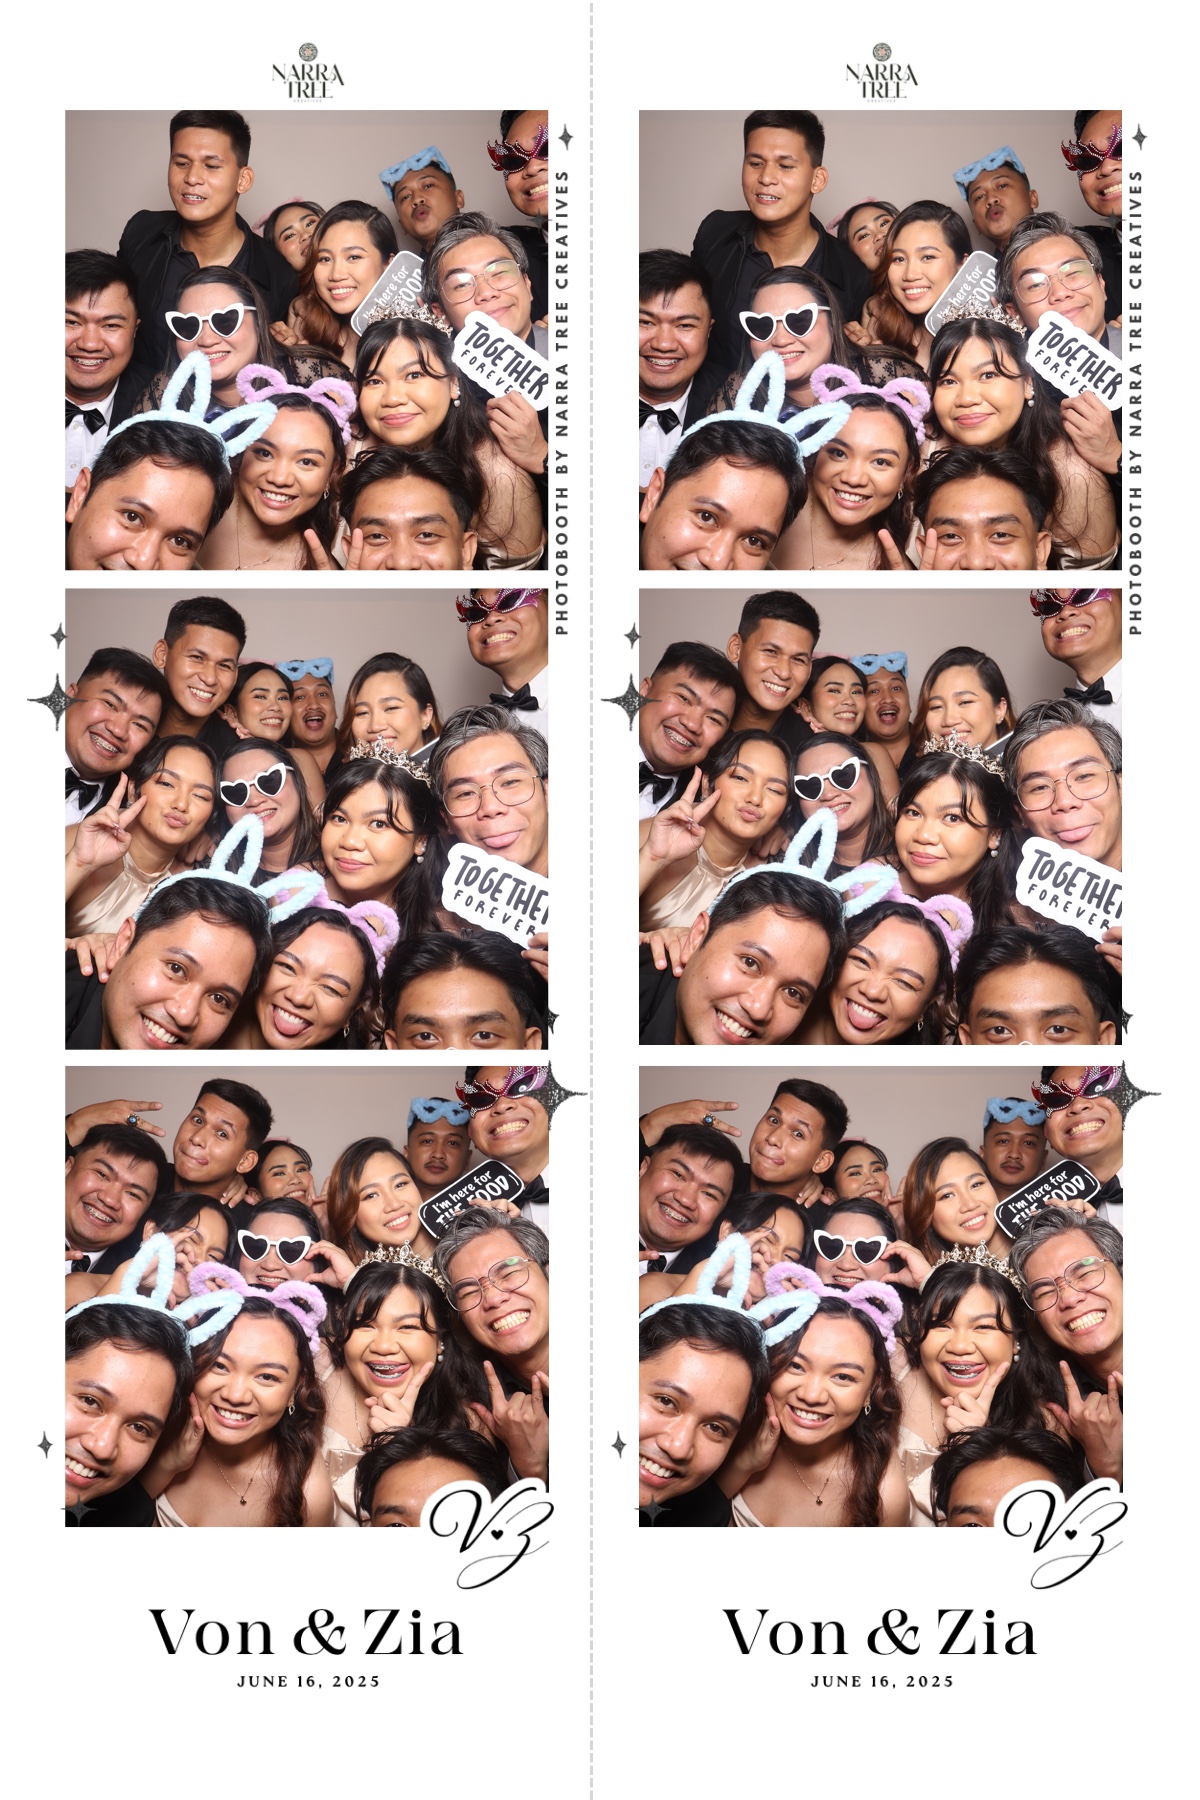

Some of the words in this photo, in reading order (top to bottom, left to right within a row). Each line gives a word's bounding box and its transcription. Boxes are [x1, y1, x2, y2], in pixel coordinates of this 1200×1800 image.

[374, 283, 397, 307] here
[392, 265, 408, 284] for
[393, 268, 423, 302] OO
[948, 283, 971, 307] here
[966, 265, 982, 284] for
[967, 268, 997, 302] OO
[461, 349, 521, 395] FOREVE
[464, 321, 548, 400] TOGETHER
[1035, 349, 1095, 395] FOREVE
[1038, 321, 1122, 400] TOGETHER
[454, 890, 536, 936] FOREVER
[1028, 884, 1110, 930] FOREVER
[432, 1200, 452, 1213] I'm
[449, 1184, 476, 1202] here
[474, 1171, 492, 1186] for
[1008, 1200, 1028, 1213] I'm
[1025, 1184, 1052, 1202] here
[1050, 1171, 1068, 1186] for
